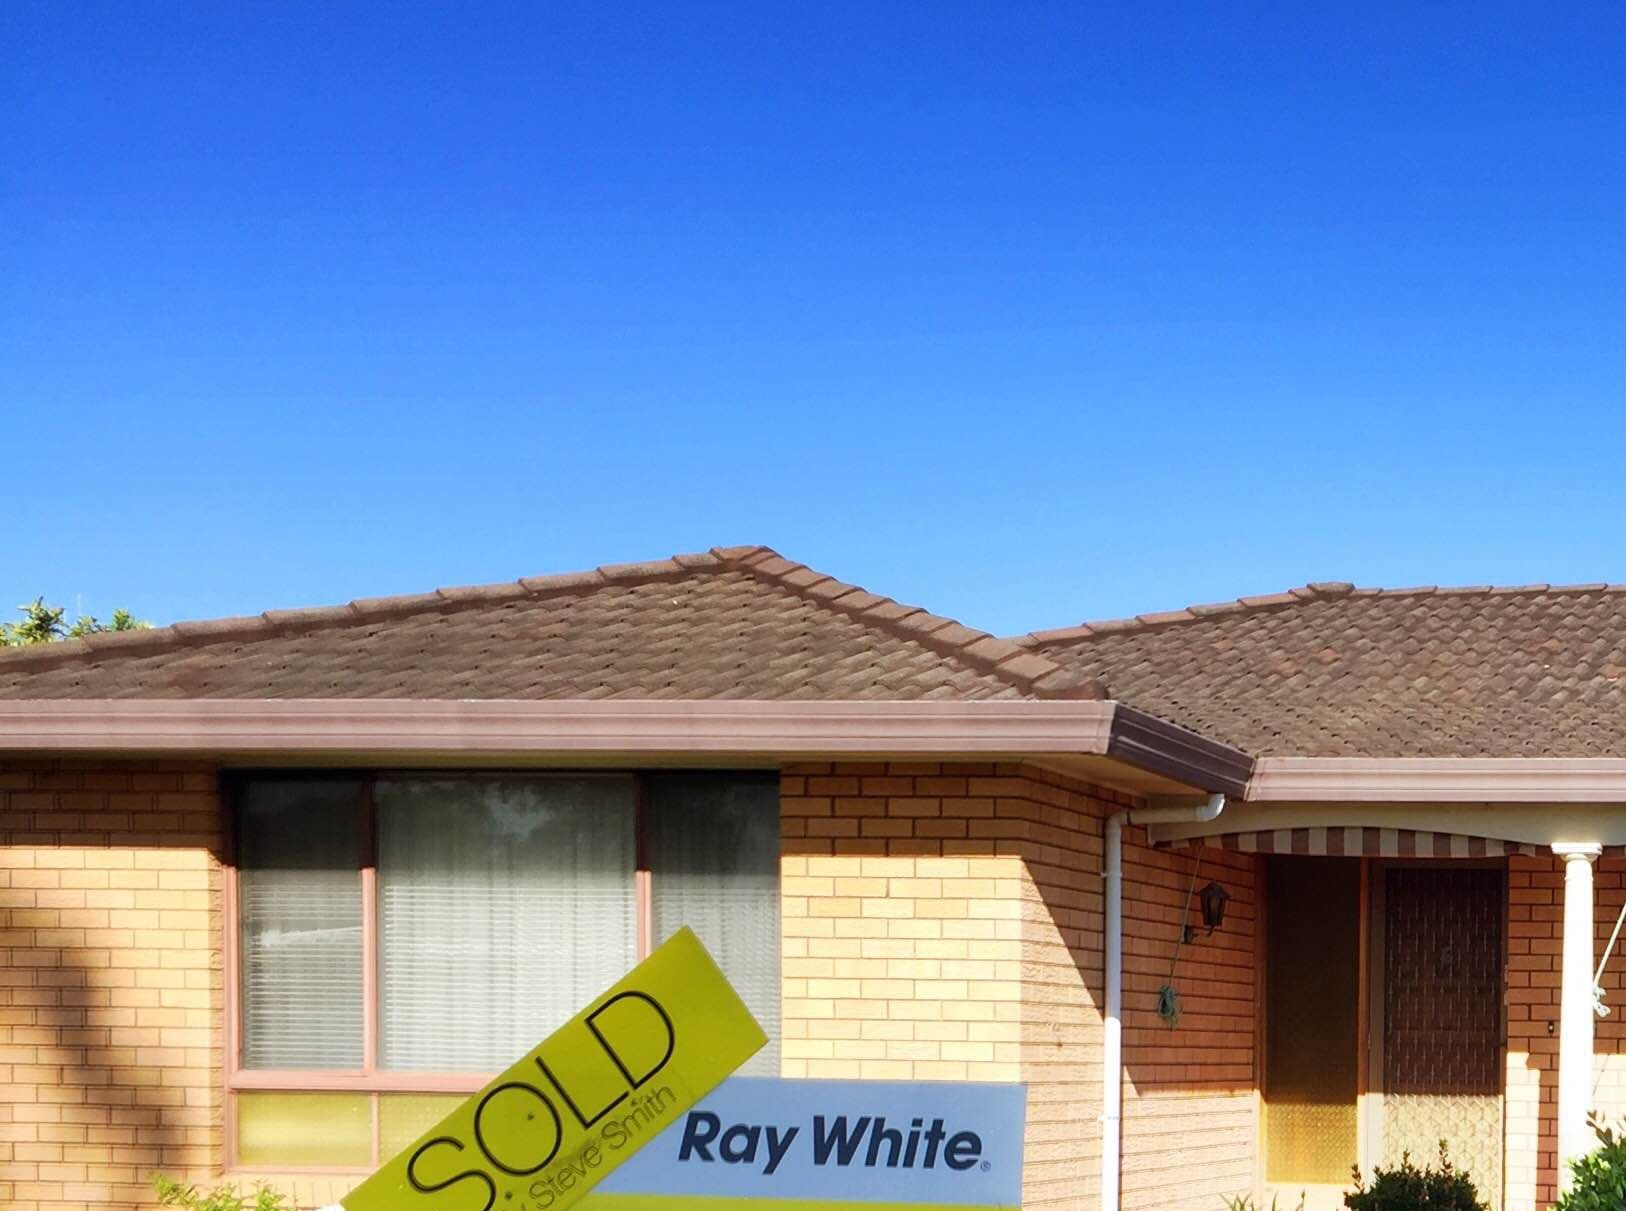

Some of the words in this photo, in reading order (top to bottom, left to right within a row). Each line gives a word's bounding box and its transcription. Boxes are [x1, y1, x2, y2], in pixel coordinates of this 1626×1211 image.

[528, 1142, 603, 1210] Steve
[601, 1085, 677, 1151] Smith
[678, 1110, 800, 1176] Ray
[813, 1115, 983, 1172] White
